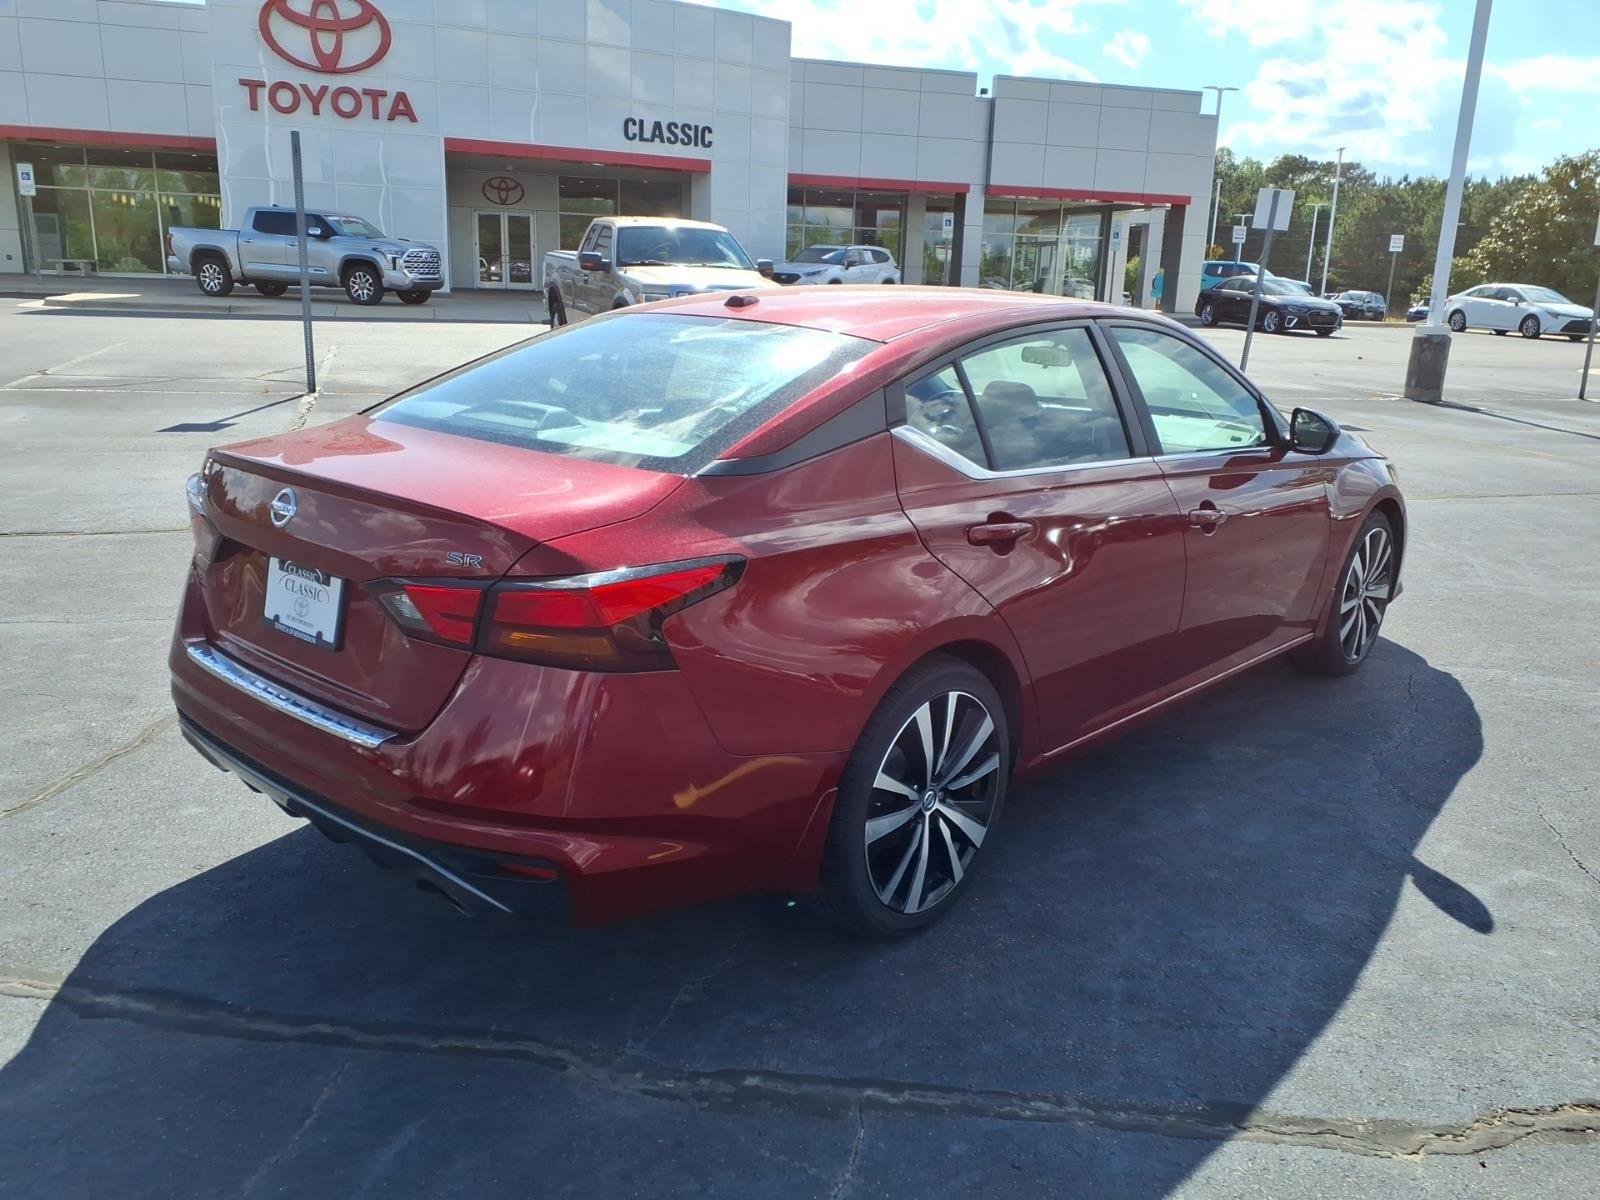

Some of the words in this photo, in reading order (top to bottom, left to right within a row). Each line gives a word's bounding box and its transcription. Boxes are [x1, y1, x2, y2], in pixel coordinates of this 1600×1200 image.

[239, 78, 418, 122] TOYOTA
[623, 117, 713, 148] CLASSIC
[446, 551, 482, 569] SR
[288, 565, 319, 583] CLASSIC
[285, 577, 325, 602] CLASSIC
